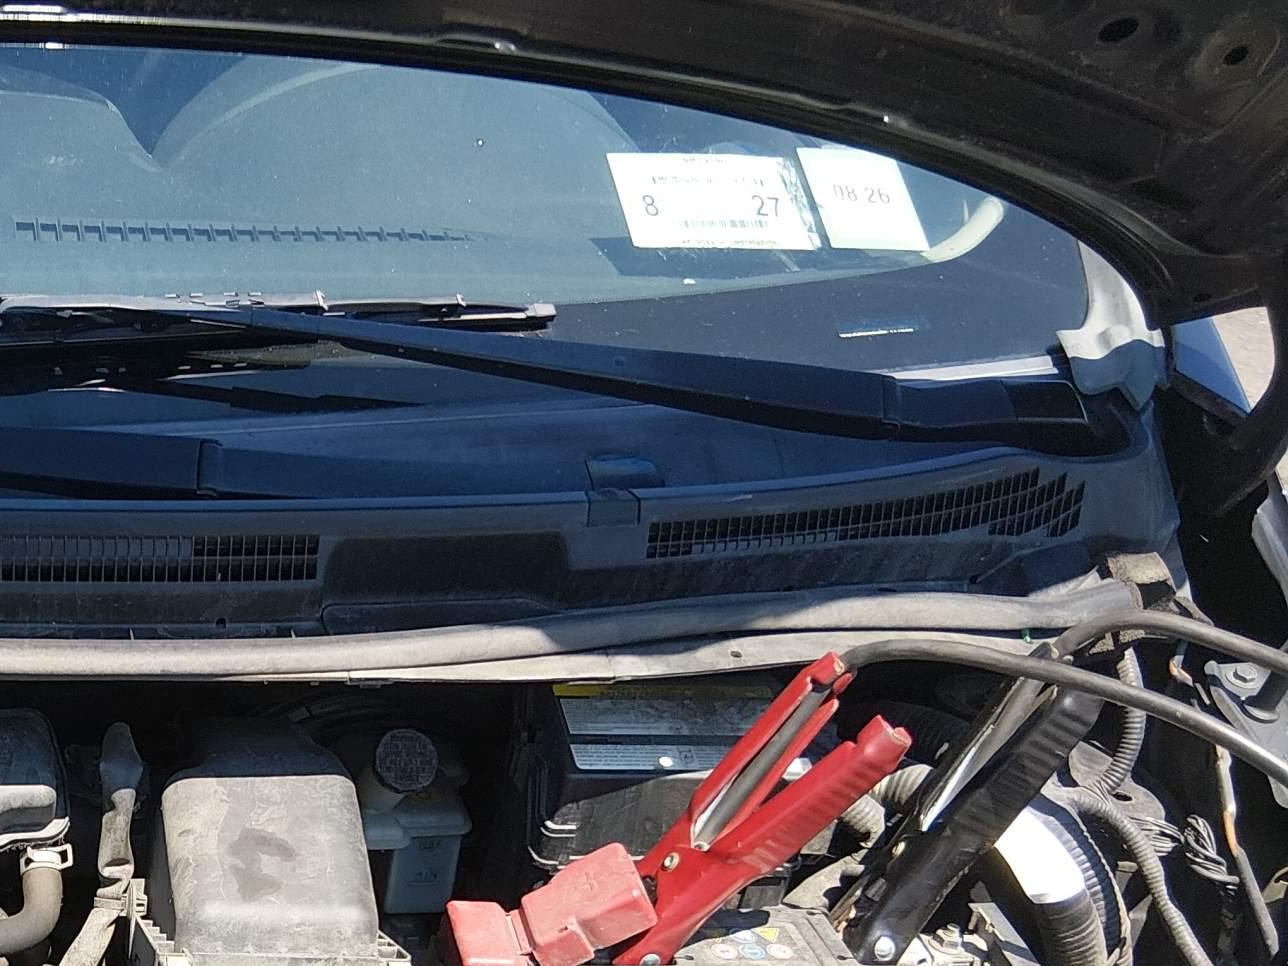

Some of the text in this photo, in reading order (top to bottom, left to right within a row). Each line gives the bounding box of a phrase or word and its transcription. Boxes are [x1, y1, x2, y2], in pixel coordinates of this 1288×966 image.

[864, 186, 891, 204] 26
[642, 194, 779, 217] 8 27
